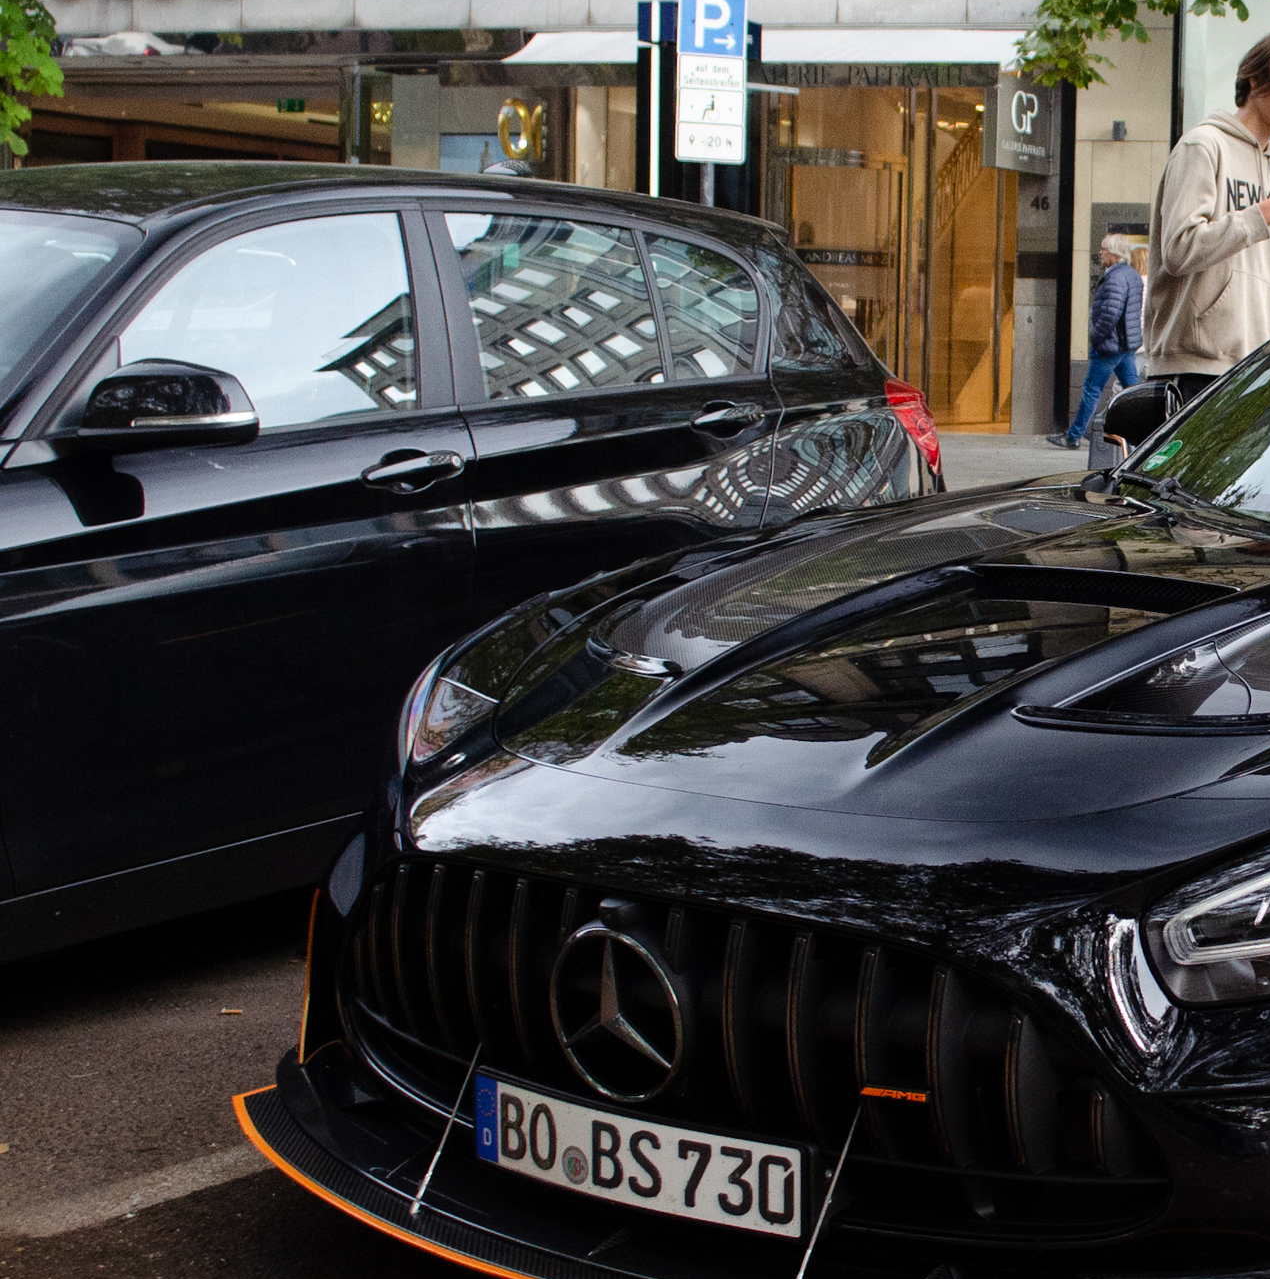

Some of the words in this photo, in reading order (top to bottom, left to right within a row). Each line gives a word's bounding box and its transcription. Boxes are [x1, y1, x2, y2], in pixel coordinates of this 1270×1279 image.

[695, 63, 708, 73] auf
[712, 64, 729, 74] dem
[683, 75, 740, 89] Seitenstreifen
[1030, 195, 1050, 211] 46
[483, 1127, 492, 1145] D
[499, 1093, 557, 1171] BO
